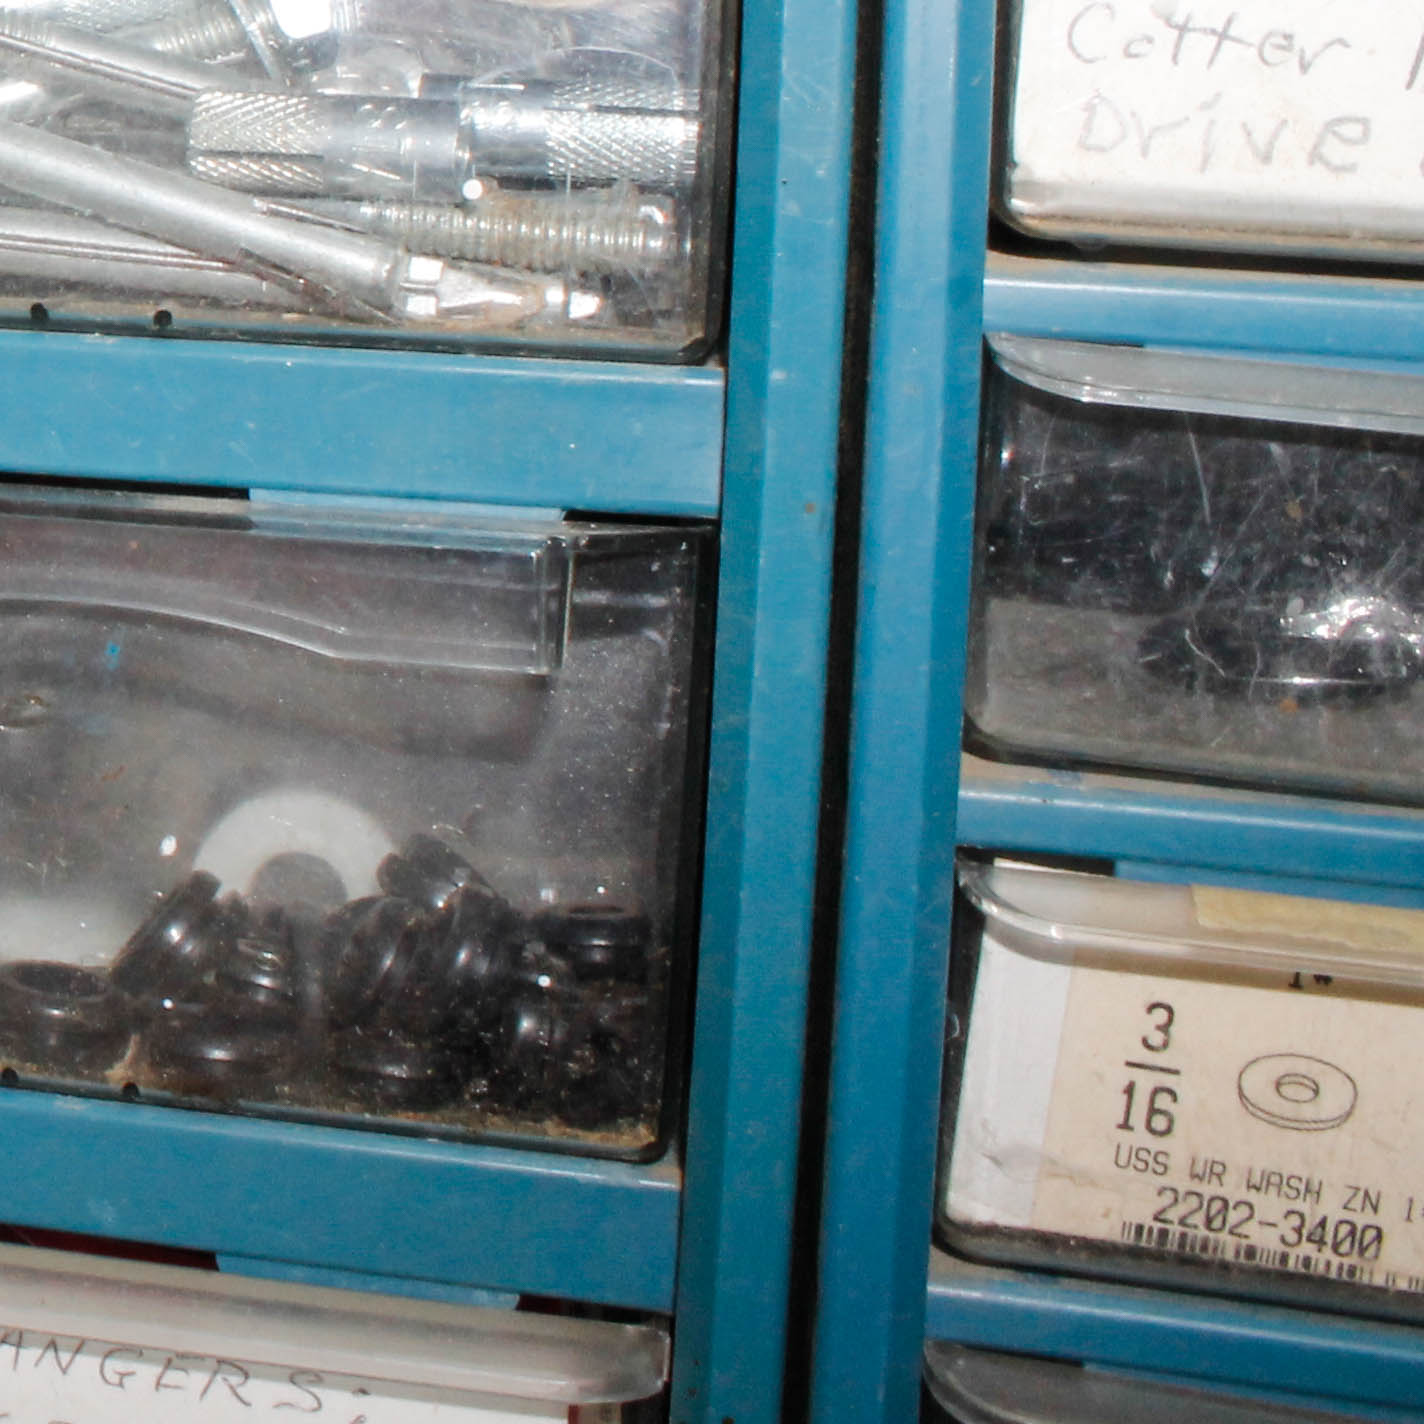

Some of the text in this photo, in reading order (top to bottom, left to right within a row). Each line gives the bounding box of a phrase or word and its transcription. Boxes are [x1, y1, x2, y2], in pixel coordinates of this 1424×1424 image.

[1140, 1001, 1175, 1053] 3
[1115, 1080, 1179, 1137] 16
[1114, 1142, 1170, 1176] USS
[1188, 1154, 1227, 1187] WR
[1246, 1168, 1323, 1206] WASH
[1343, 1184, 1381, 1215] ZN
[1152, 1186, 1383, 1261] 2202-3400
